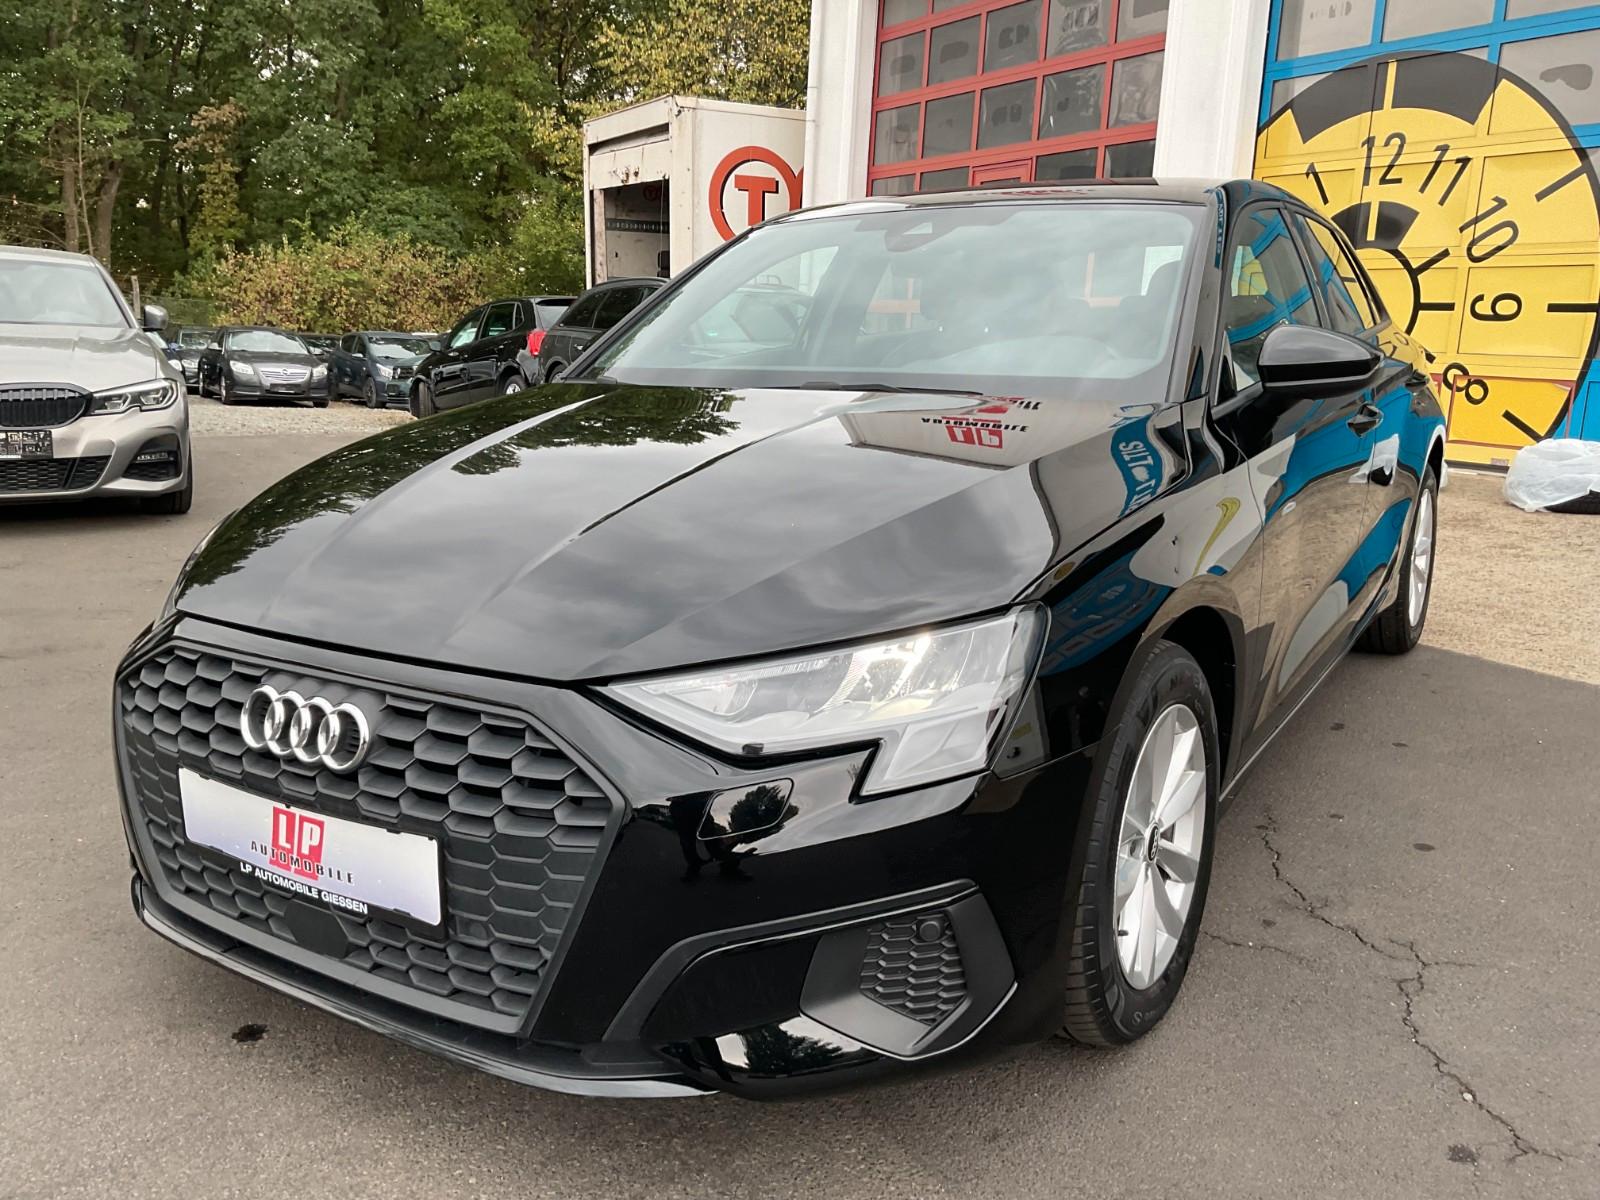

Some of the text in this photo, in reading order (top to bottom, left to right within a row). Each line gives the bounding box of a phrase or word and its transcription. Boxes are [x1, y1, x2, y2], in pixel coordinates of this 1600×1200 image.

[1305, 162, 1329, 205] 1
[1361, 132, 1407, 187] 12
[1418, 144, 1473, 206] 11
[1458, 195, 1519, 263] 10
[1442, 362, 1489, 405] 8
[278, 813, 321, 855] LP
[251, 840, 354, 886] AUTOMOBILE
[240, 862, 369, 914] LP AUTOMOBILE GIESSEN
